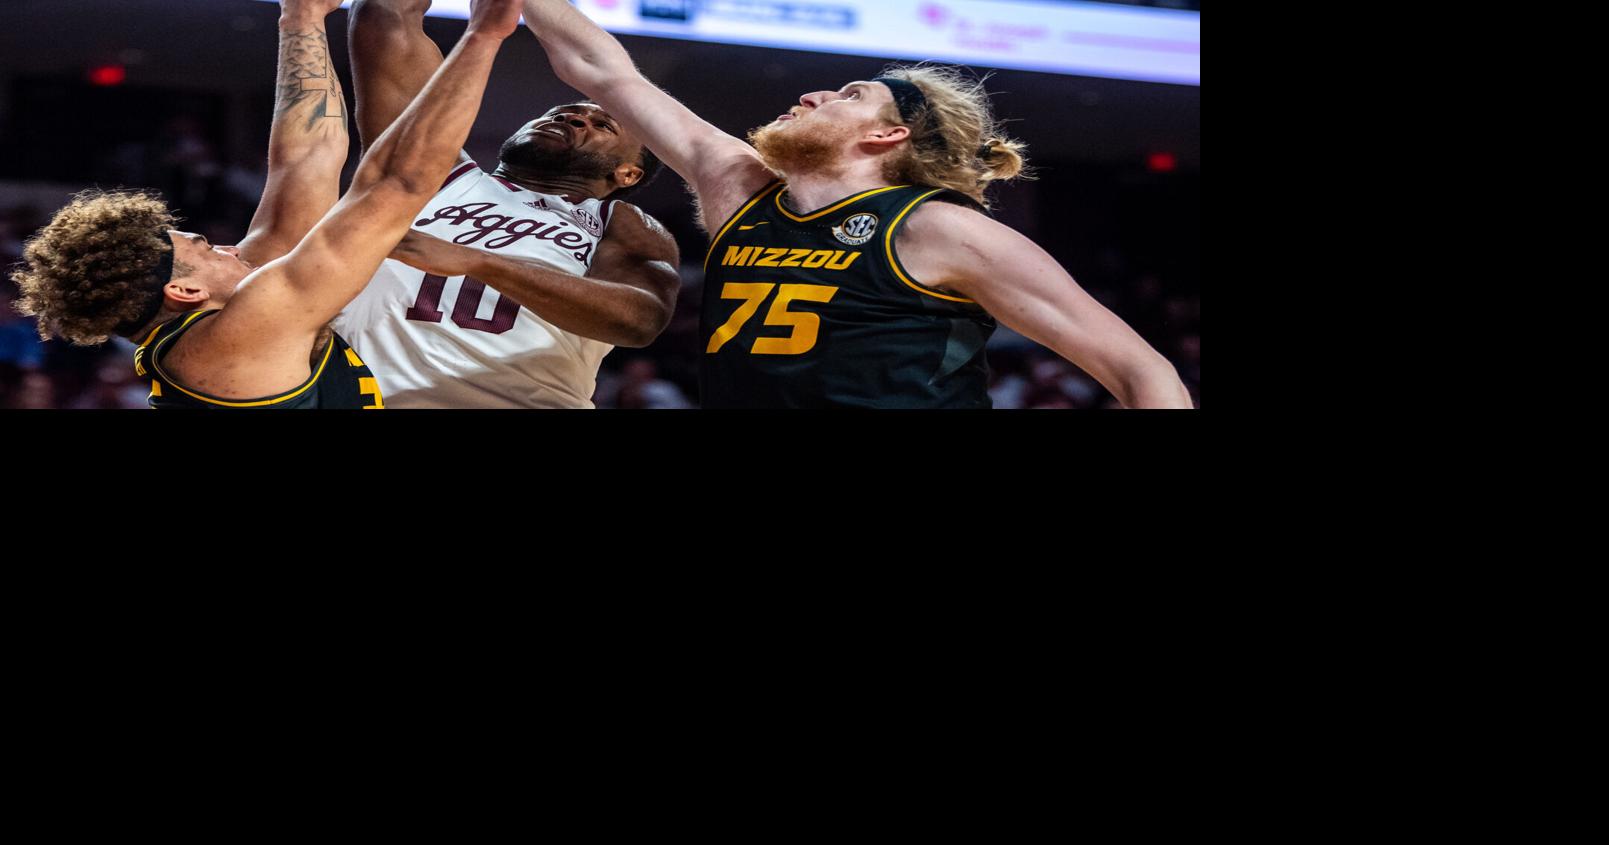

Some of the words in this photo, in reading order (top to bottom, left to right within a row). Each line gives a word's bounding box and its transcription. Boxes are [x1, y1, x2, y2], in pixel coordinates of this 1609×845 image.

[415, 202, 595, 268] Aggies
[845, 214, 876, 237] SEC
[721, 245, 861, 270] MIZZOU
[706, 282, 839, 355] 75
